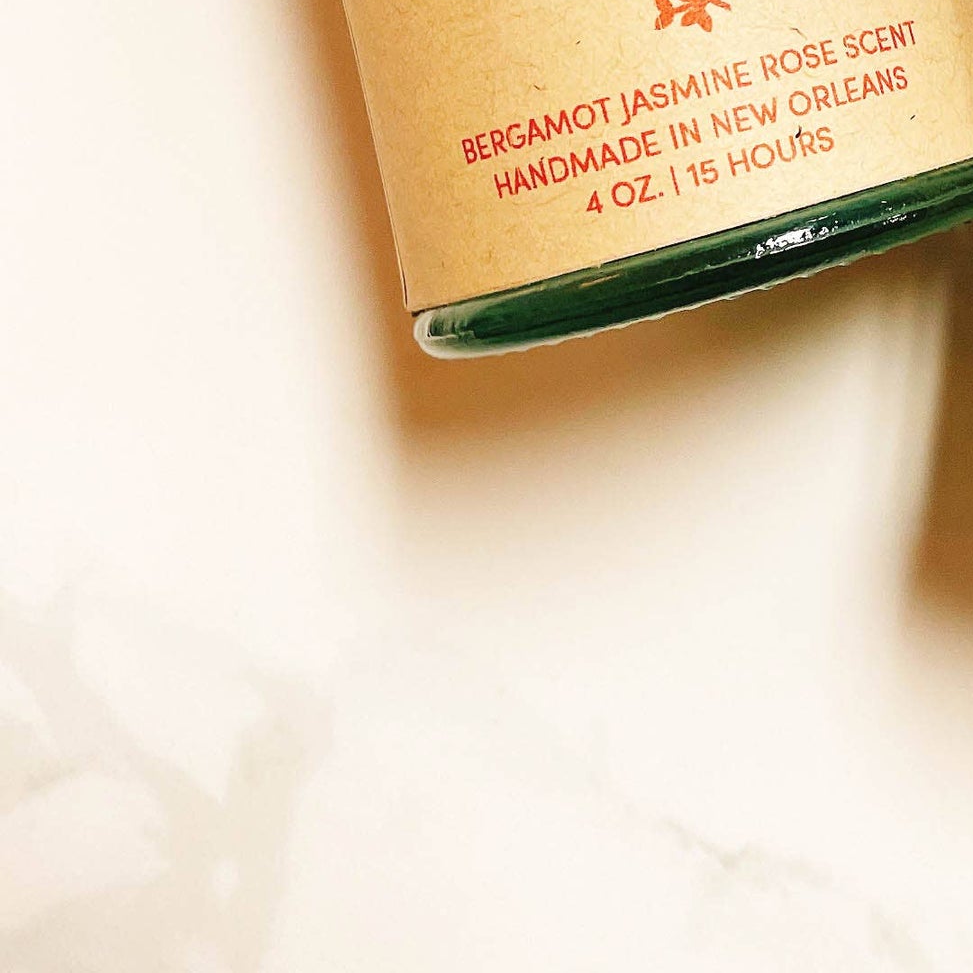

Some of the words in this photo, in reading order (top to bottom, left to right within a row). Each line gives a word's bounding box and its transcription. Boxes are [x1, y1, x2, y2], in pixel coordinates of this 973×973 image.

[462, 97, 610, 164] BERGAMOT
[620, 62, 752, 126] JASMINE
[761, 40, 838, 80] ROSE
[843, 21, 915, 59] SCENT
[494, 130, 662, 199] HANDMADE
[669, 119, 701, 149] IN
[711, 99, 776, 137] NEW
[789, 66, 908, 116] ORLEANS
[586, 191, 603, 214] 4
[611, 174, 664, 207] OZ.
[687, 160, 719, 186] 15
[728, 127, 834, 176] HOURS
